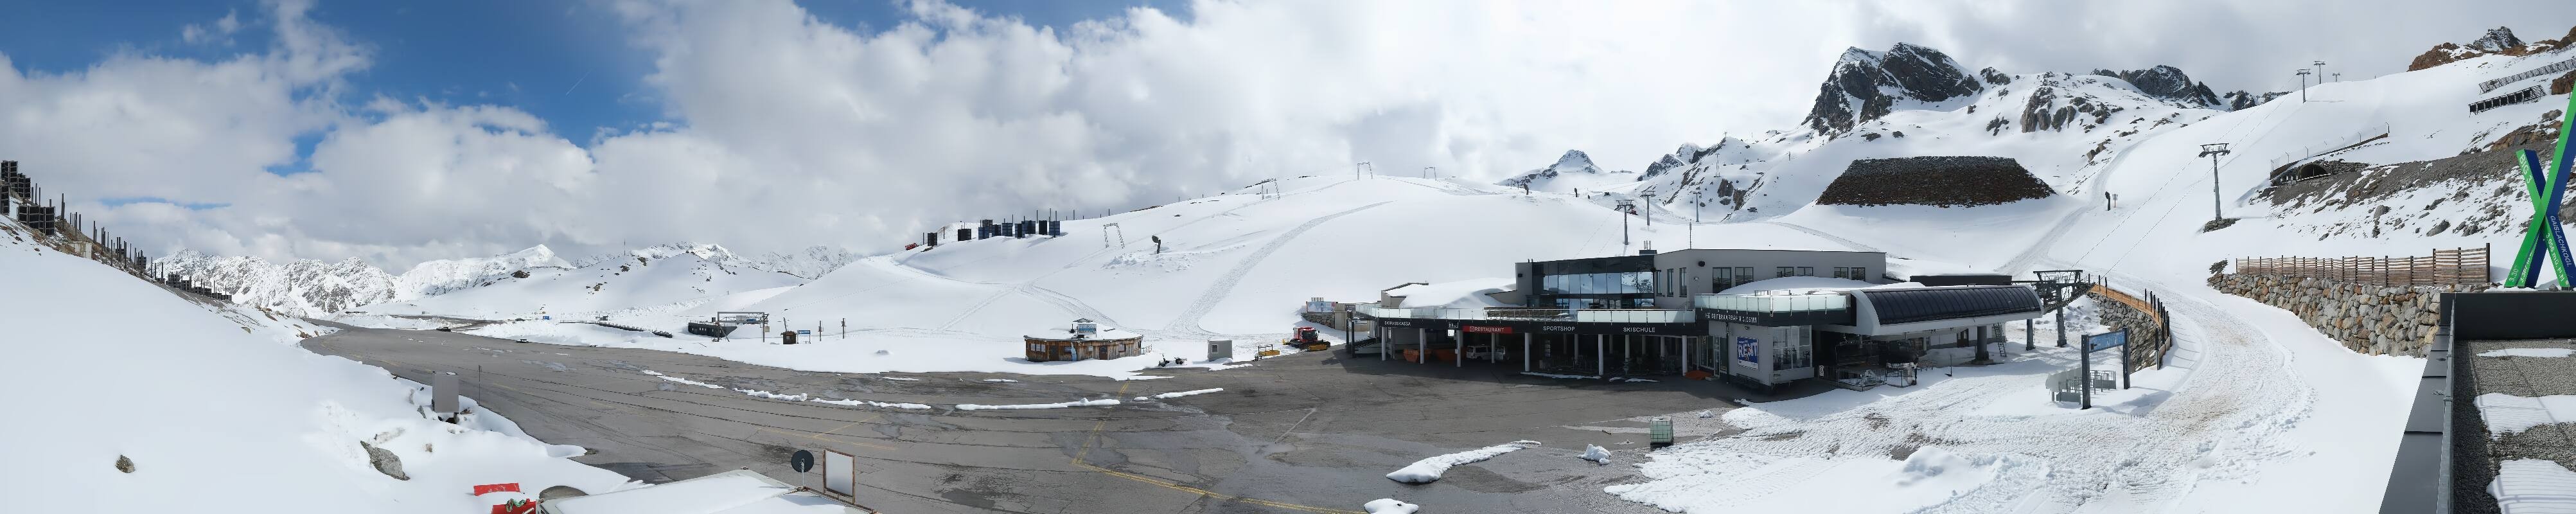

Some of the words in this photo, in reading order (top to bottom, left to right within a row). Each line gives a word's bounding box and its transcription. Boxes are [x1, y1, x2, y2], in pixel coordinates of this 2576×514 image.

[2519, 153, 2529, 175] BIG
[2527, 175, 2532, 184] 3
[2550, 215, 2572, 267] GAISLACHKOGL
